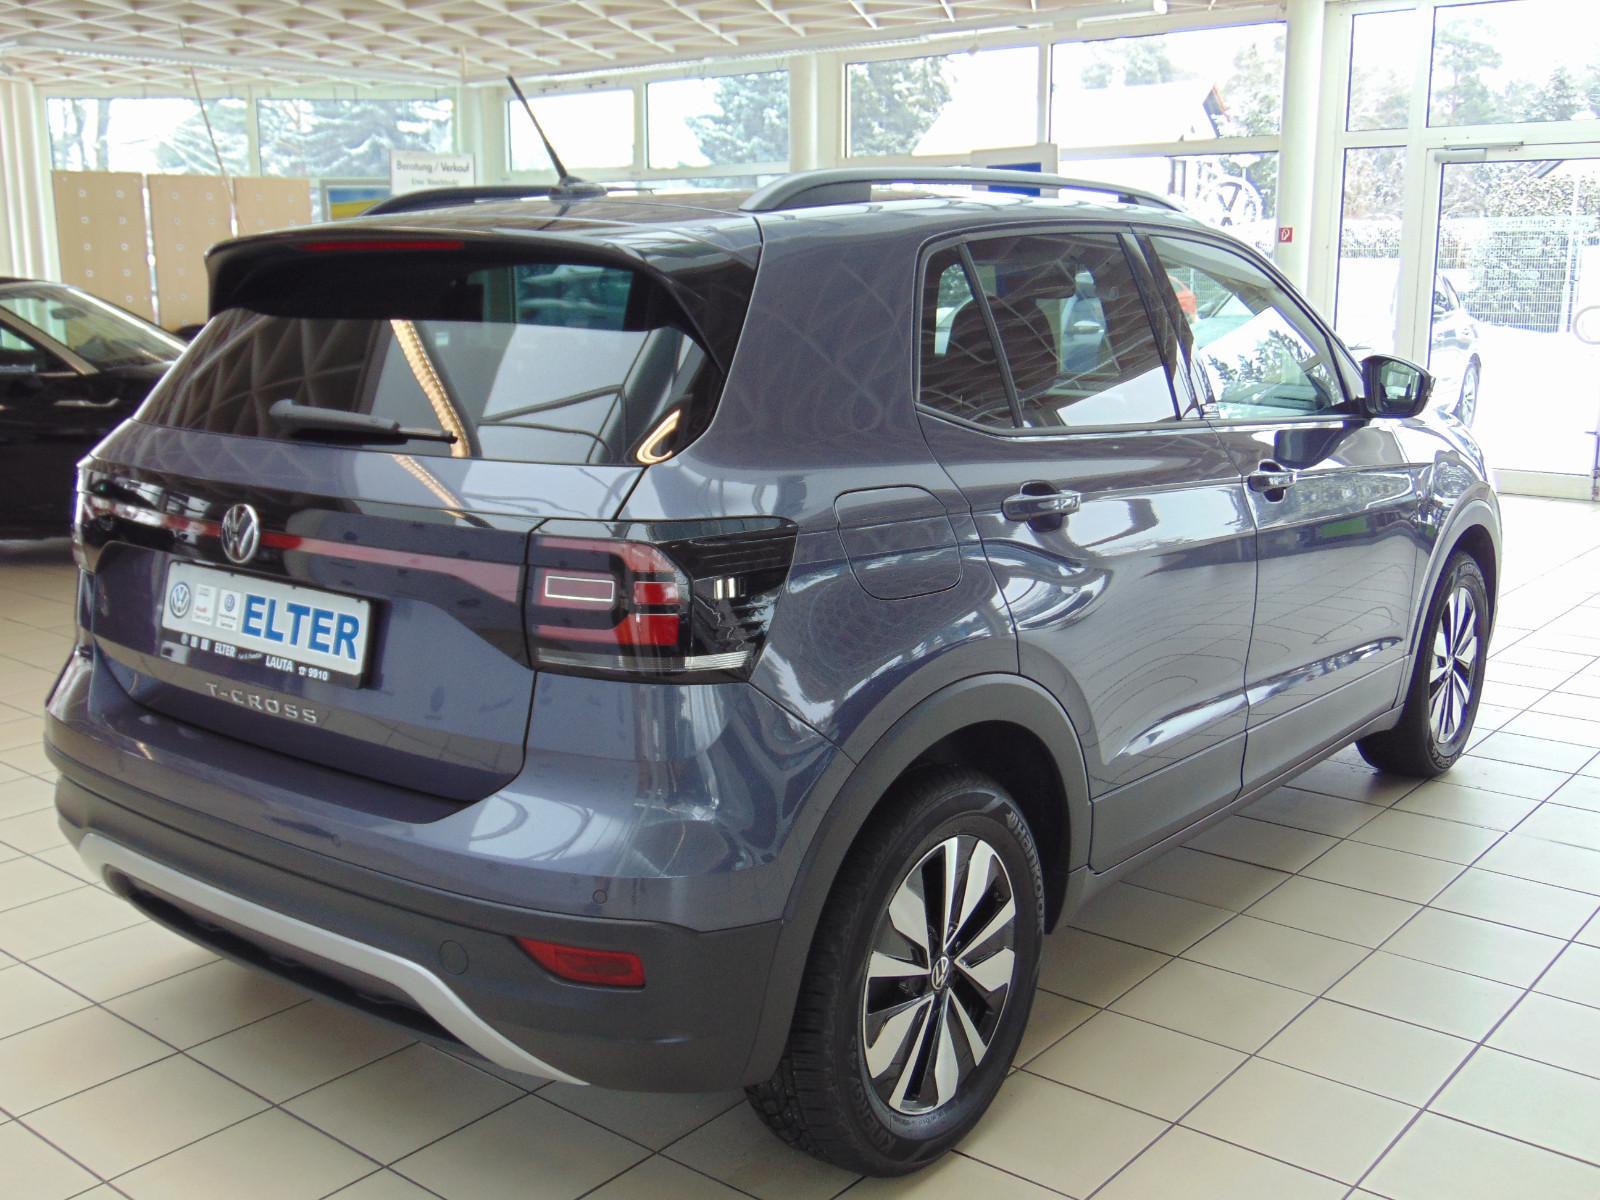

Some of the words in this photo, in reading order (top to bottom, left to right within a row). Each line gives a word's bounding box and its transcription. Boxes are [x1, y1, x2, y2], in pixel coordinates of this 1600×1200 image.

[241, 593, 360, 660] ELTER
[214, 642, 236, 657] ELTER
[265, 655, 294, 673] LAUTA
[206, 682, 317, 724] T-CROSS
